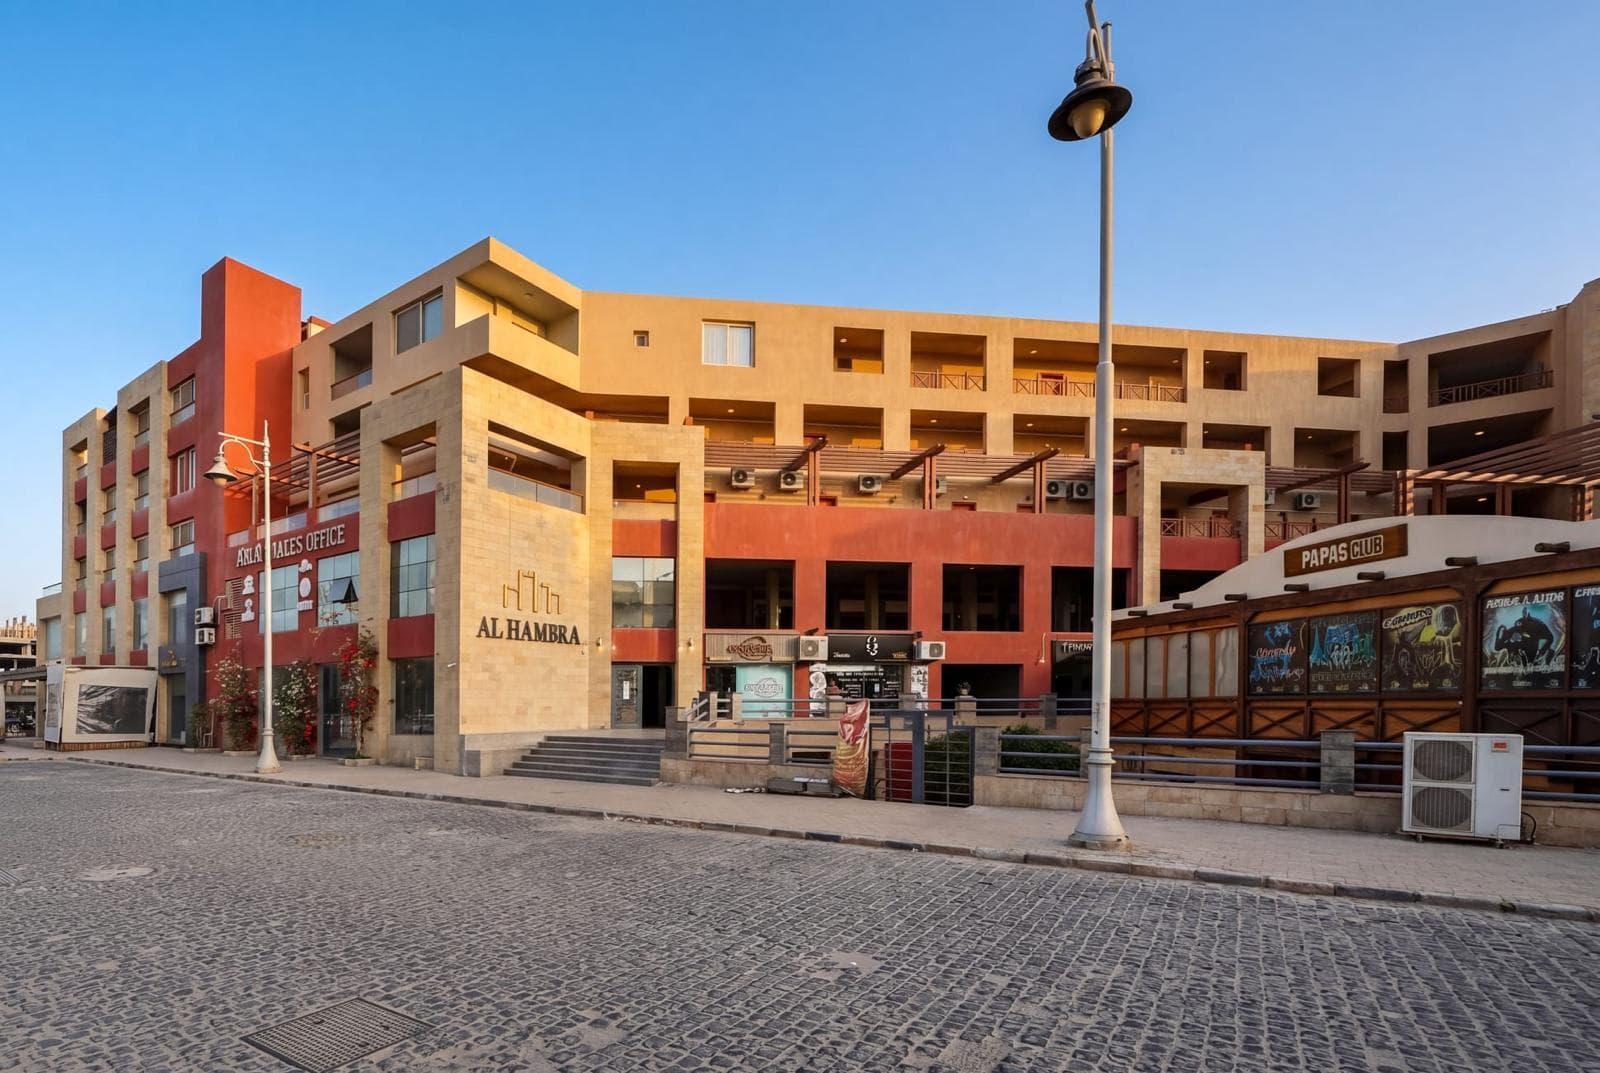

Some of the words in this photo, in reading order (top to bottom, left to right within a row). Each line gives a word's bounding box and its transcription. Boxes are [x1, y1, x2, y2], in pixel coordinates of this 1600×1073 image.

[306, 524, 345, 552] OFFICE
[1302, 542, 1348, 569] PAPAS
[1351, 535, 1383, 560] CLUB
[476, 616, 504, 639] AL
[506, 618, 581, 645] HAMBRA
